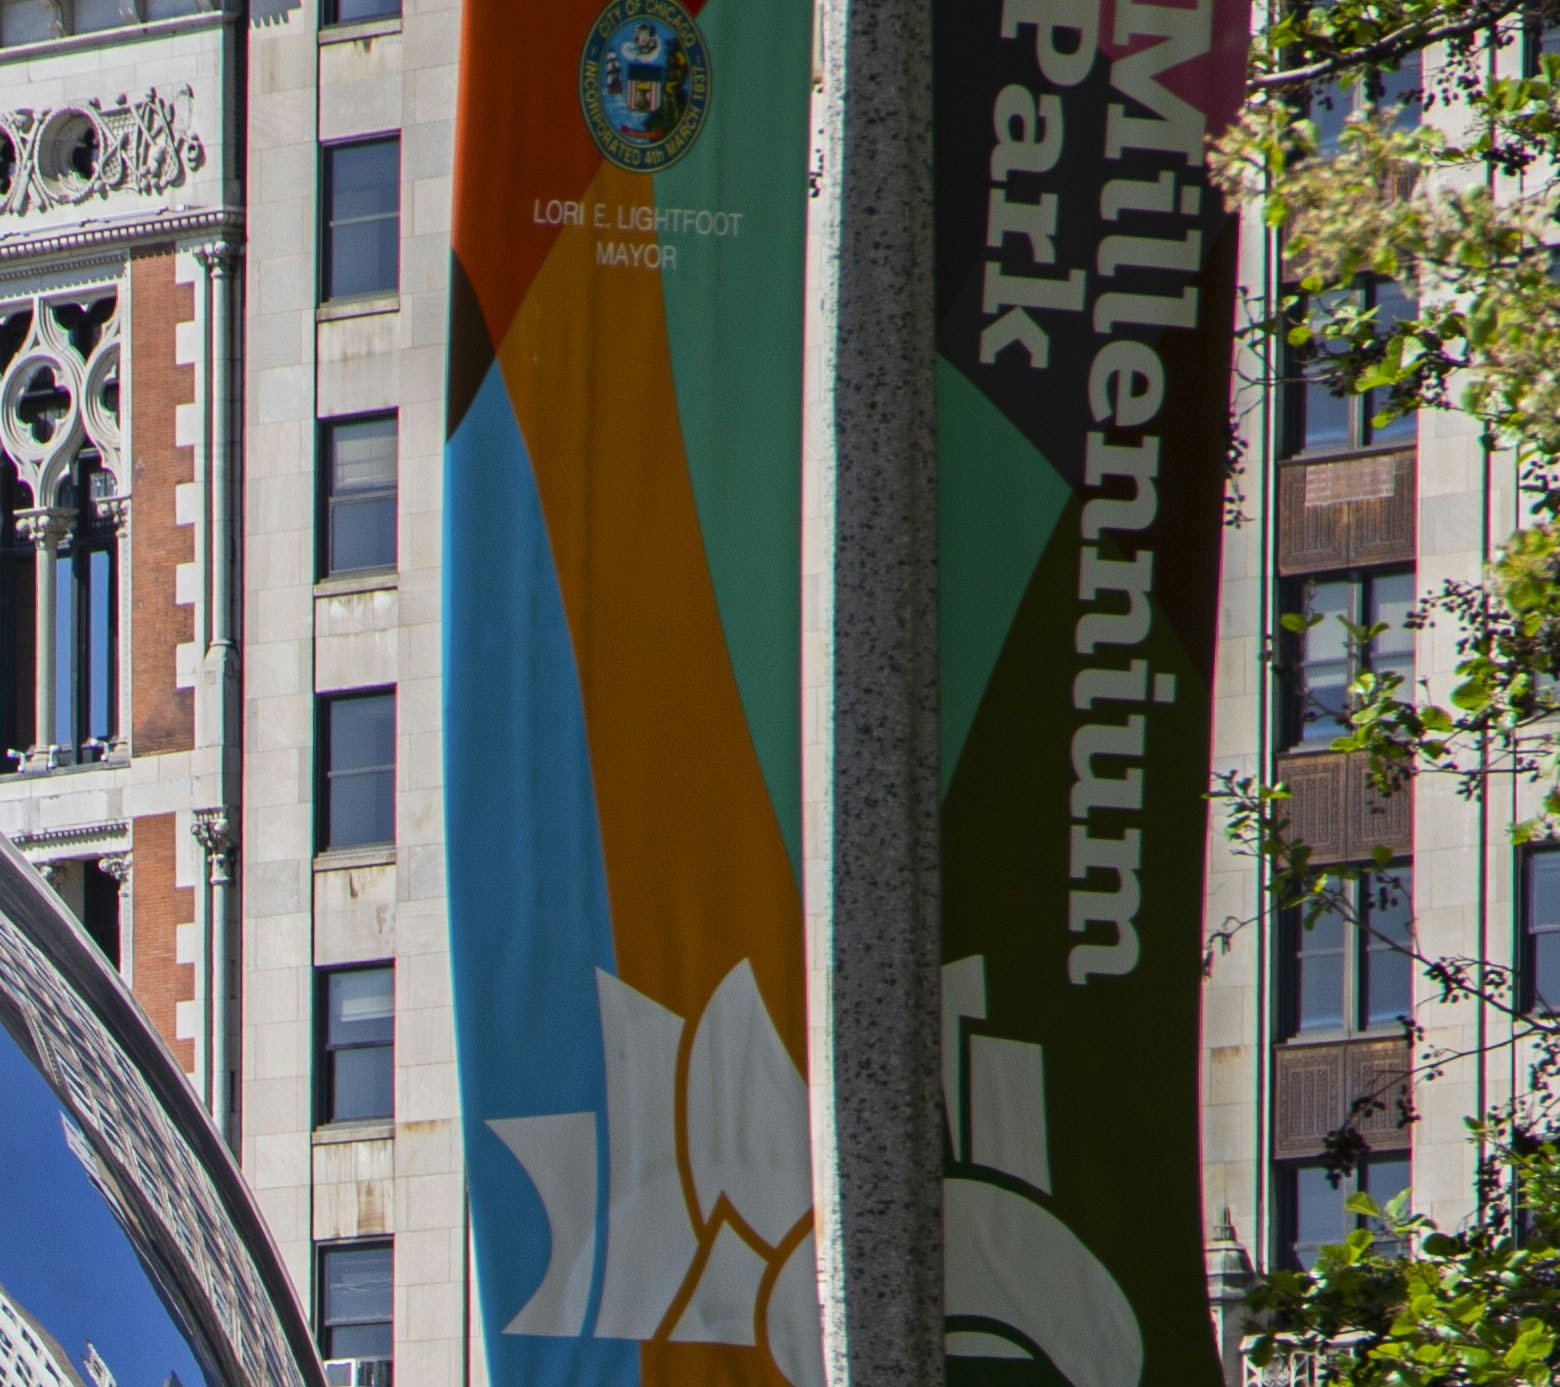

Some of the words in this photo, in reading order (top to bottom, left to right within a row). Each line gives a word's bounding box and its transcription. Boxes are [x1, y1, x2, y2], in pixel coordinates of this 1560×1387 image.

[600, 8, 621, 38] CITY
[624, 0, 641, 15] OF
[646, 0, 696, 48] CHICAGO
[584, 60, 641, 165] INCORPORATED
[667, 108, 700, 157] MARCH
[692, 65, 706, 100] 1837
[533, 199, 584, 226] LORI
[594, 204, 610, 228] E.
[617, 206, 743, 237] LIGHTFOOT
[979, 0, 1100, 368] Park
[596, 241, 677, 270] MAYOR
[1068, 0, 1212, 985] Millennium
